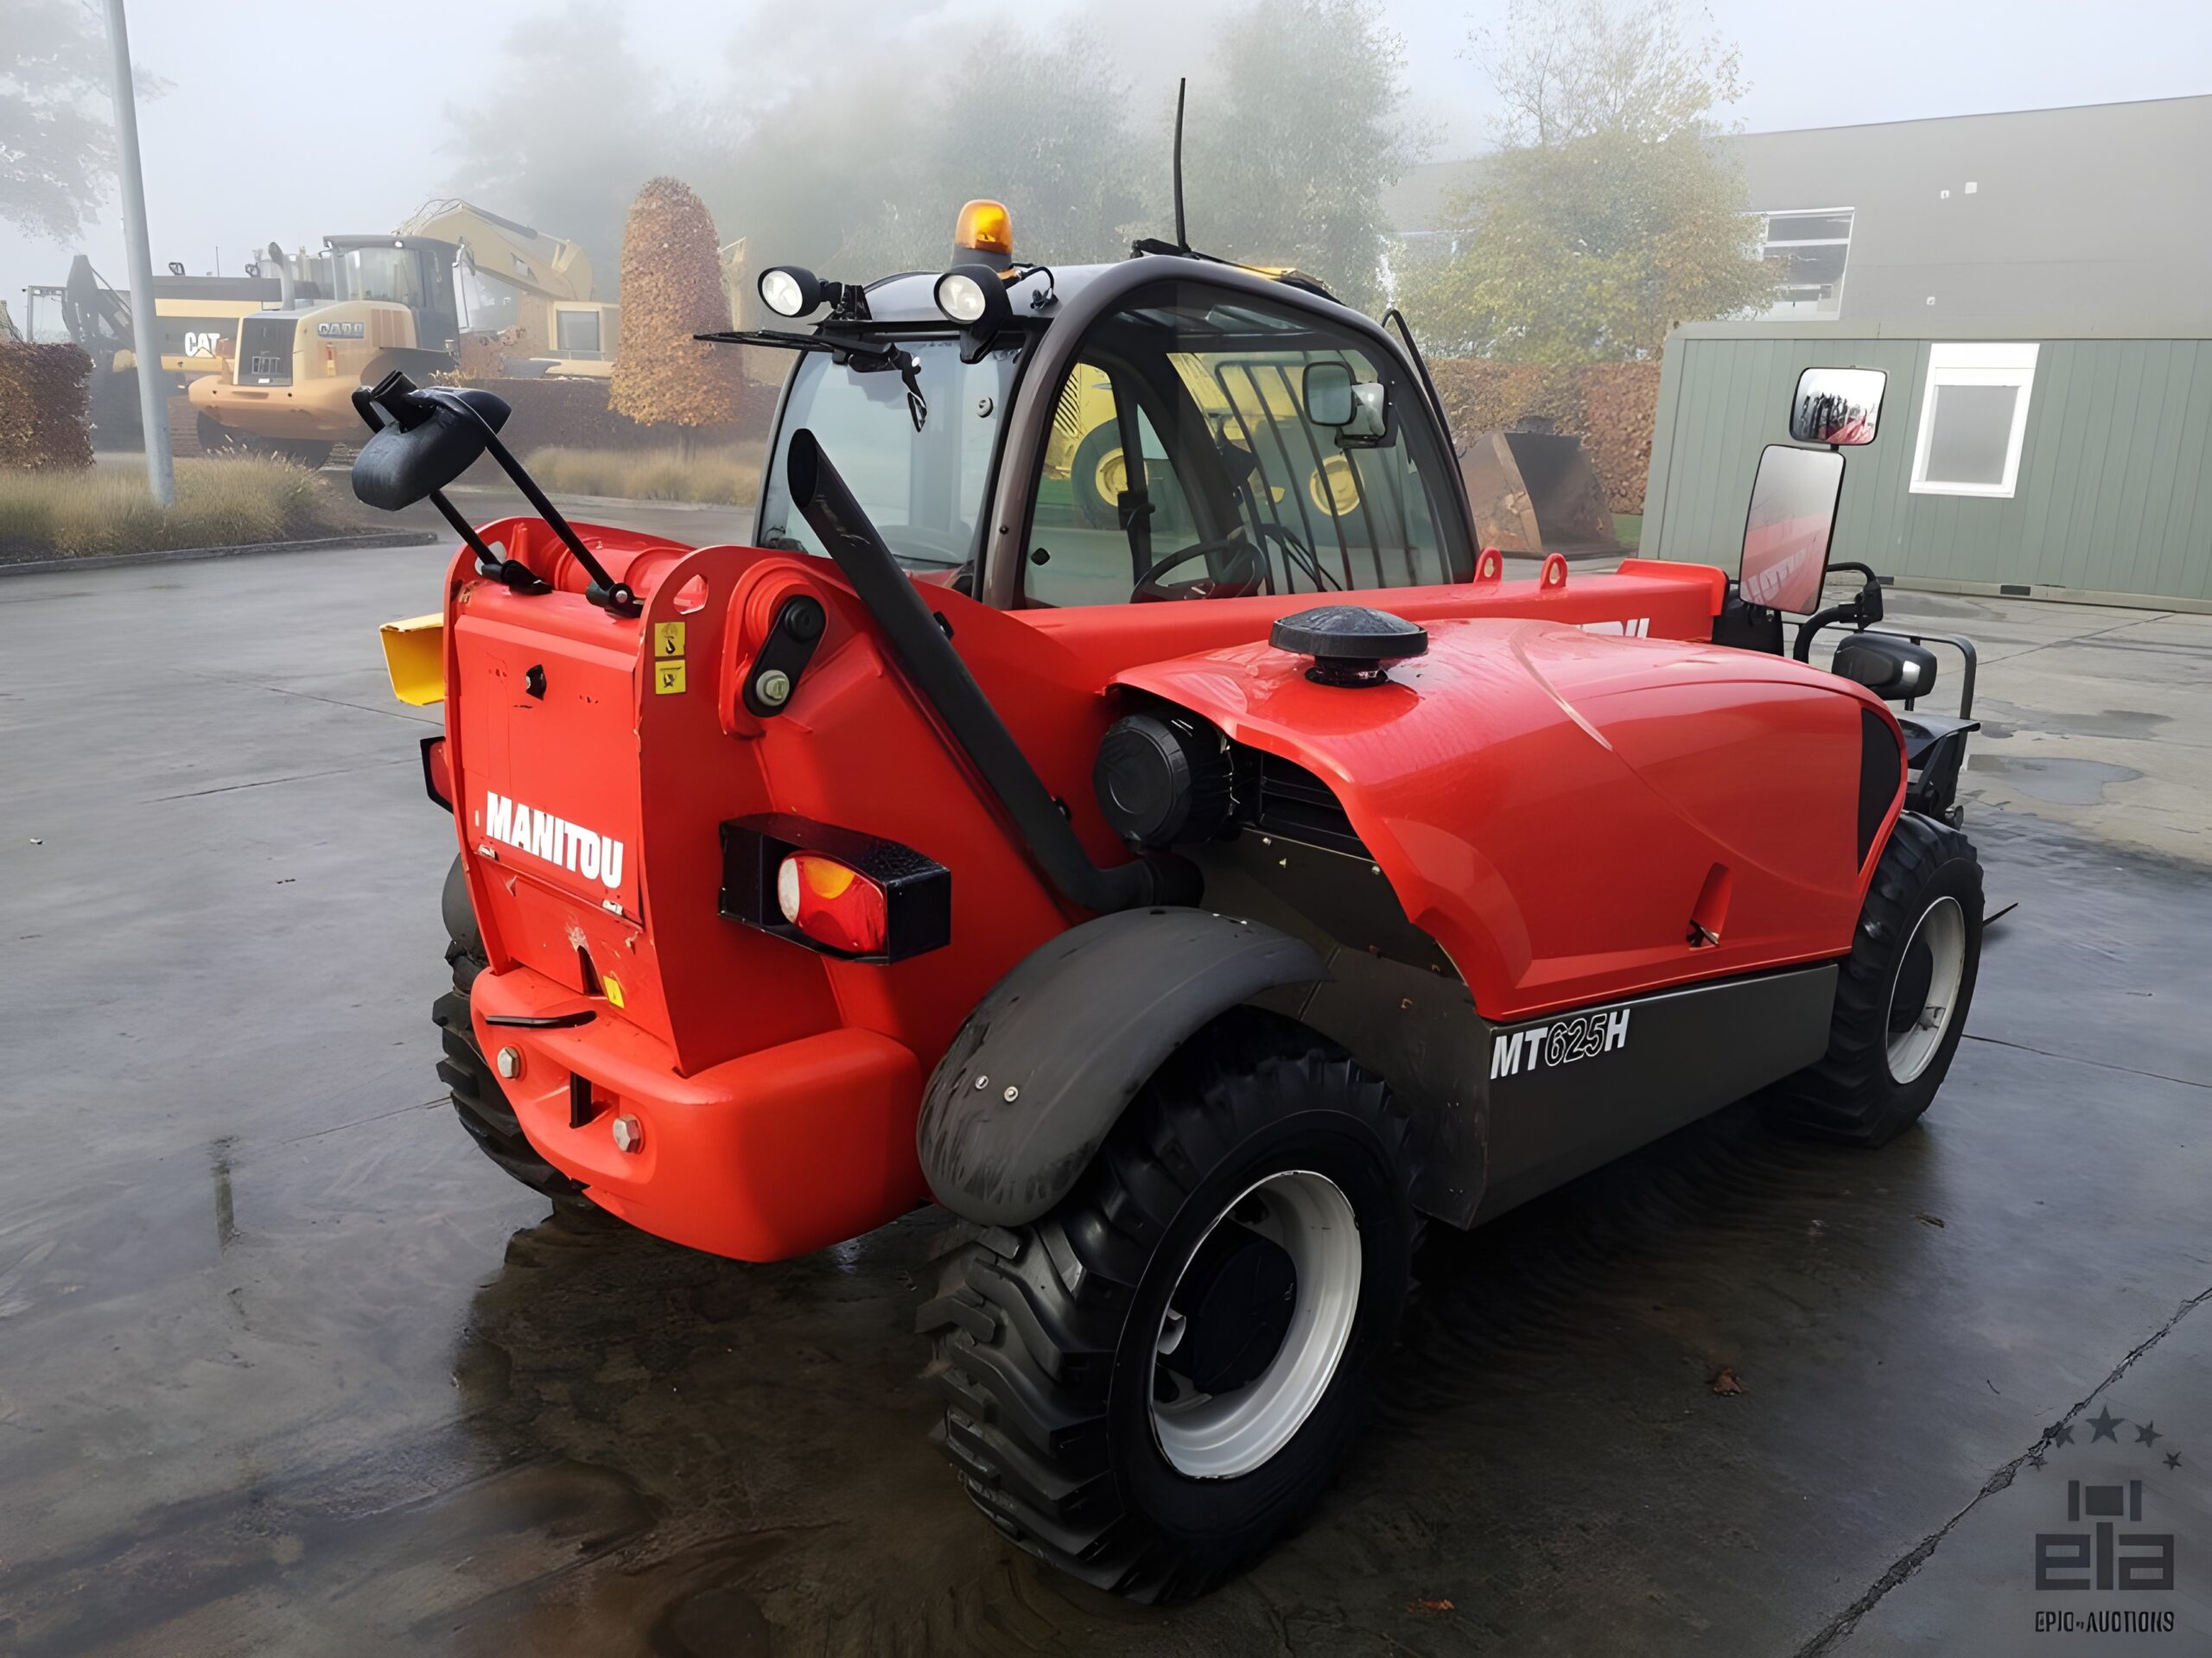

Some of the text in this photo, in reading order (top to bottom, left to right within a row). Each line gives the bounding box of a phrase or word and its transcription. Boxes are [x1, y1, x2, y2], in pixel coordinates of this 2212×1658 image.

[185, 332, 220, 357] CAT
[486, 791, 624, 889] MANITOU
[1490, 1009, 1630, 1080] MT625H
